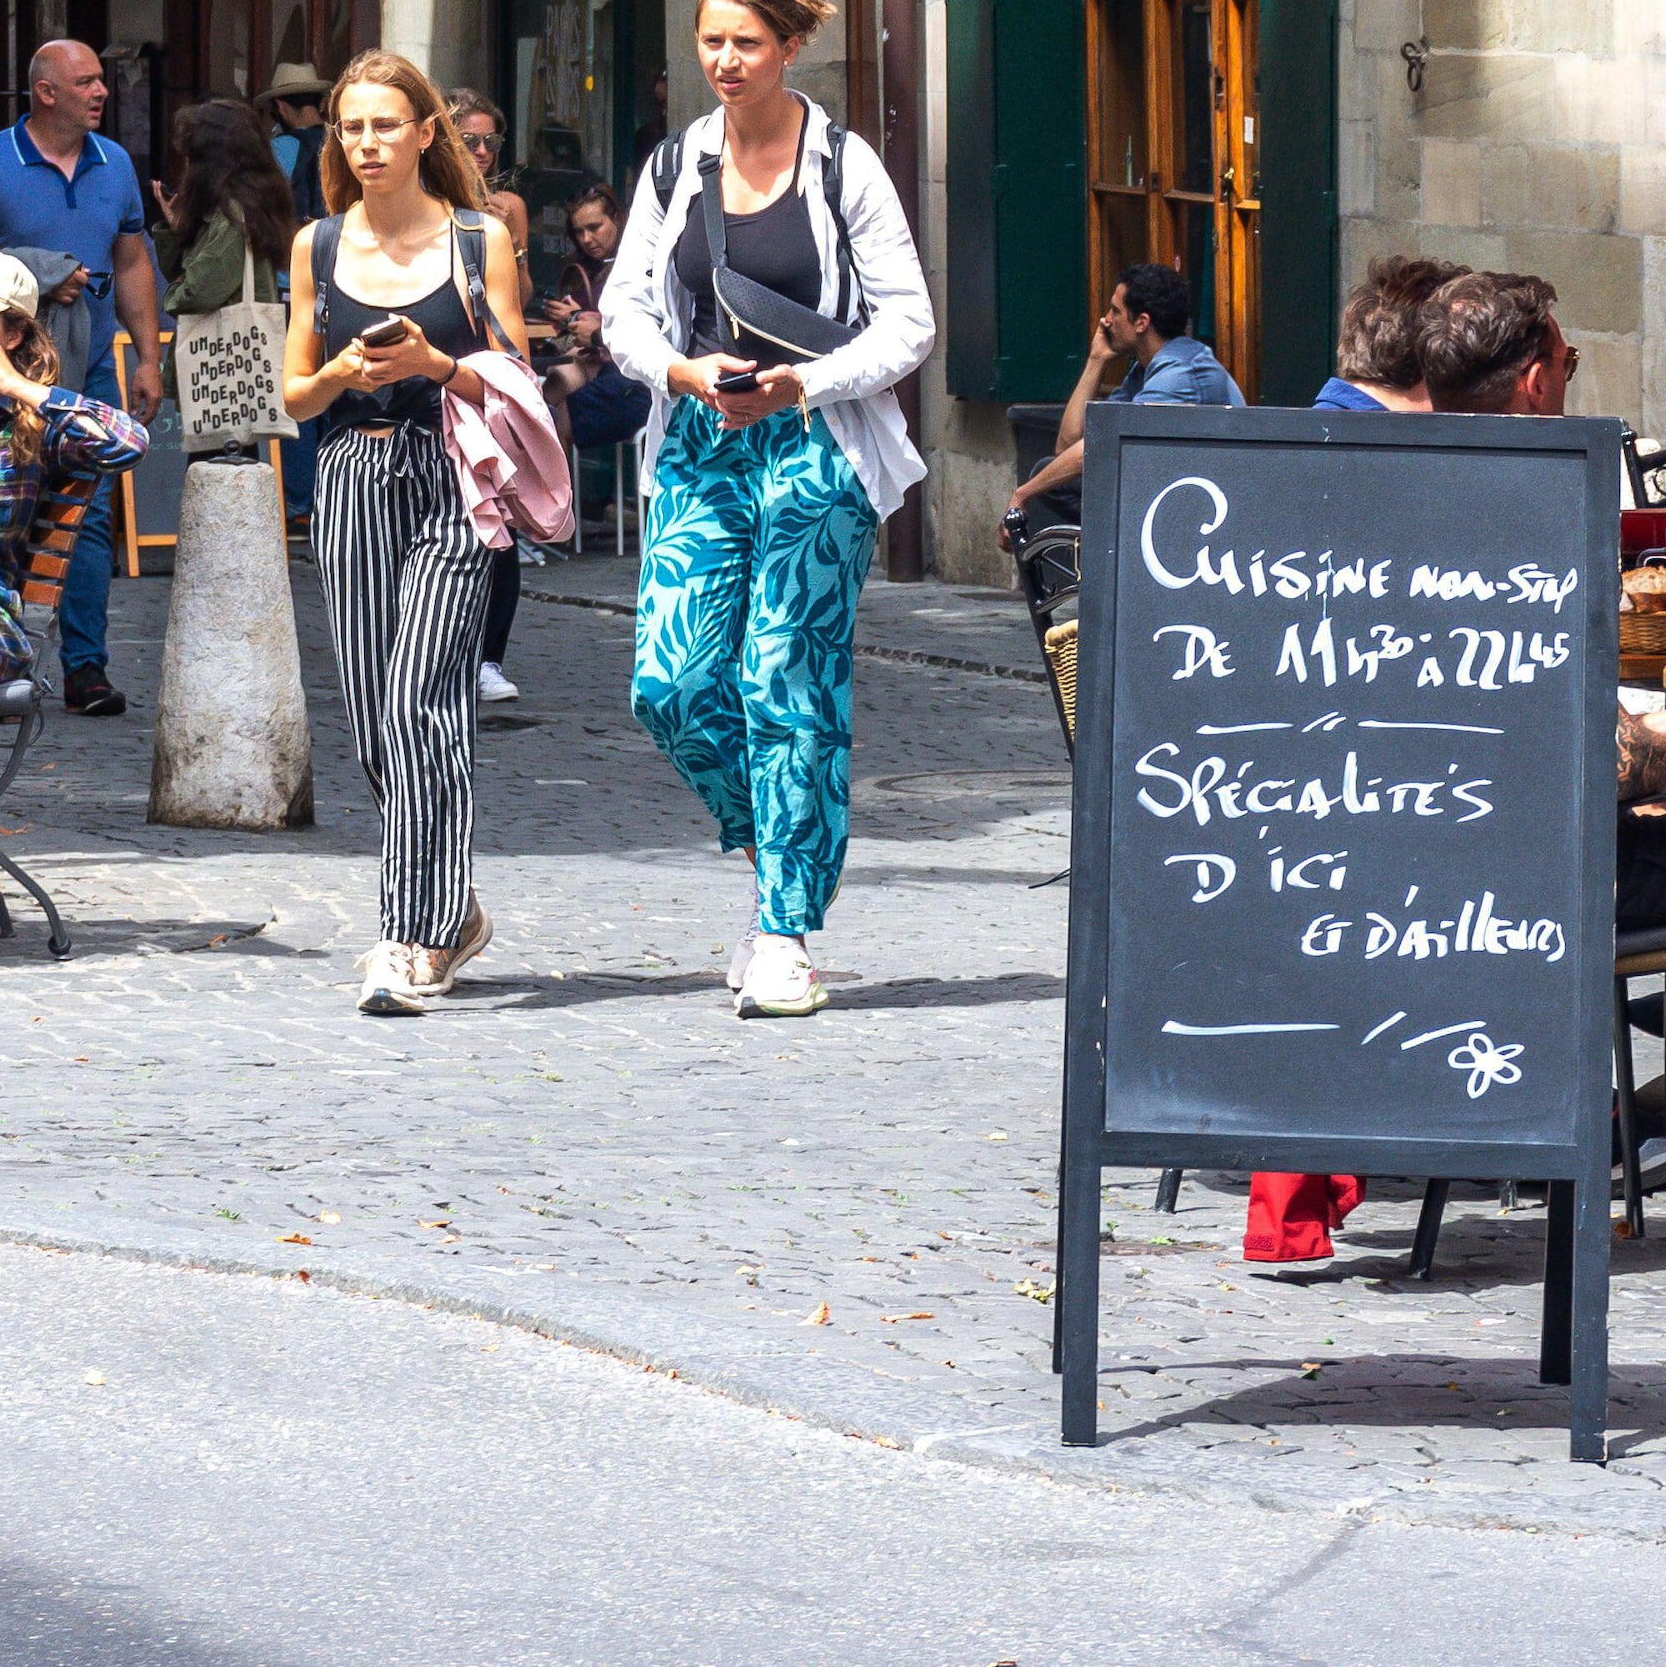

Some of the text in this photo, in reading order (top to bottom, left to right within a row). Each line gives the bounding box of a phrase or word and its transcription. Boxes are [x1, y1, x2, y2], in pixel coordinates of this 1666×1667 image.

[189, 325, 268, 357] UNDERDOGS
[191, 347, 273, 387] UNDERDOGS
[191, 374, 275, 405] UNDERDOGS
[192, 396, 278, 435] UNDERDOGS
